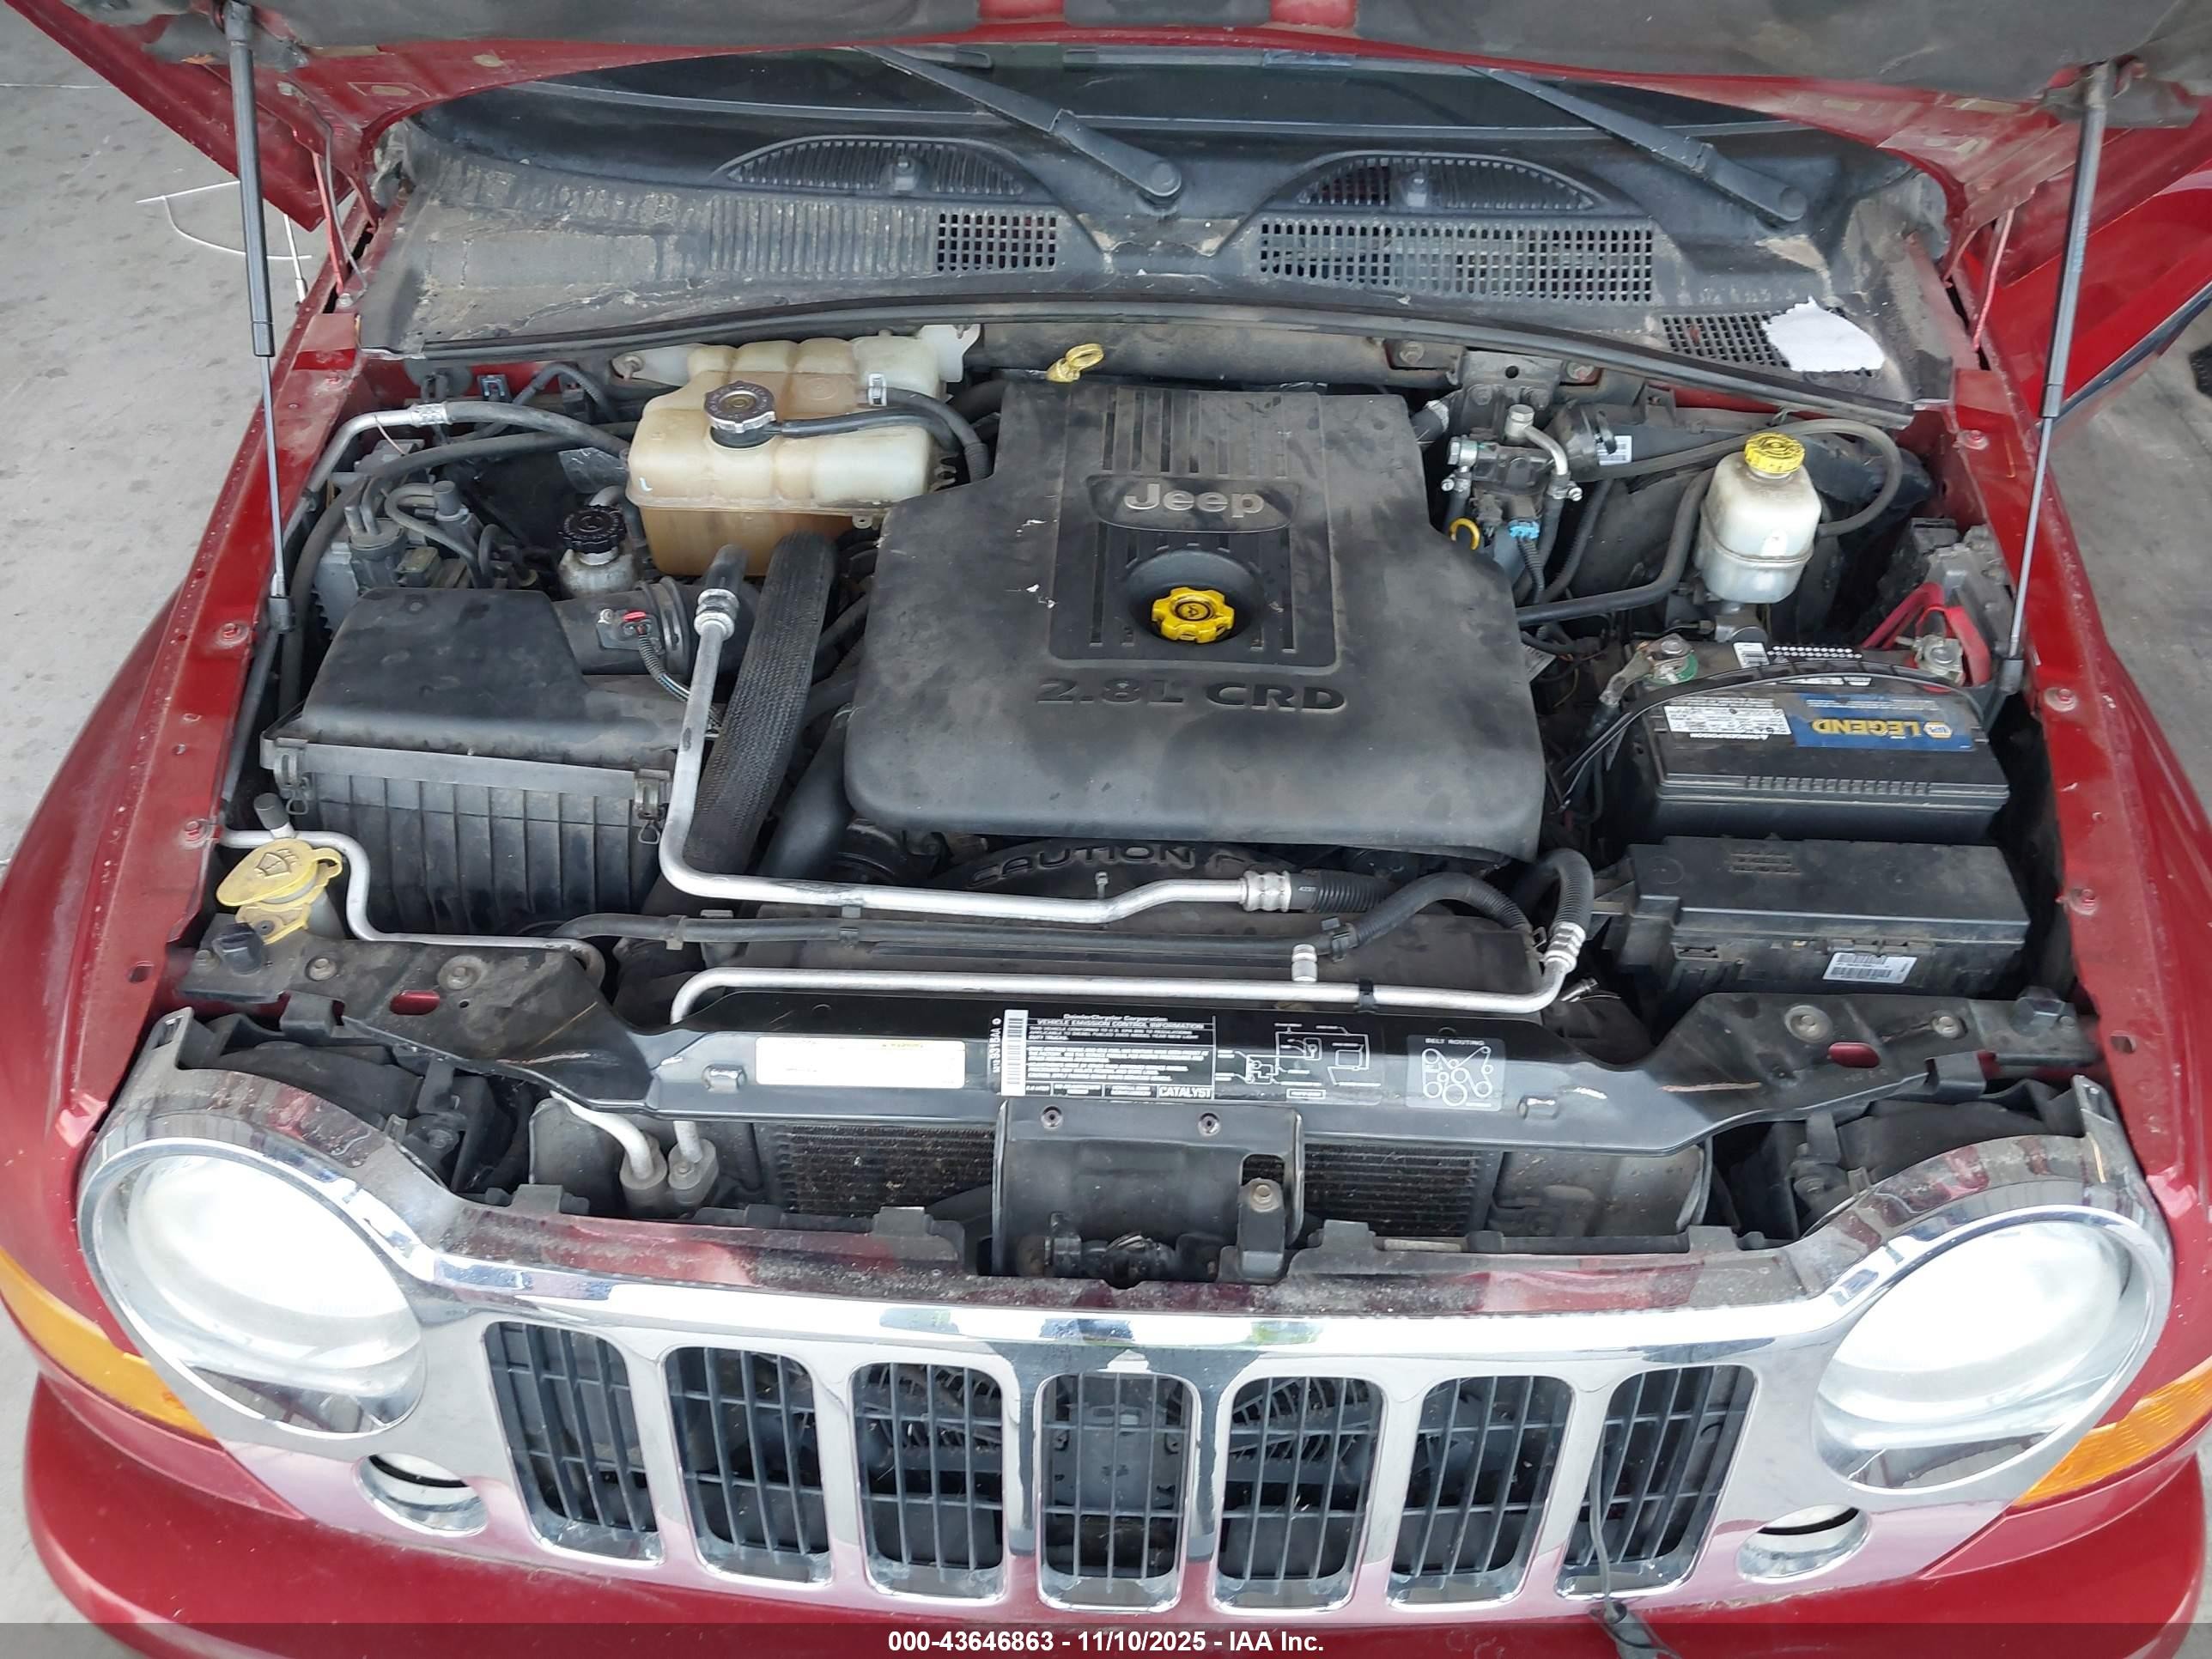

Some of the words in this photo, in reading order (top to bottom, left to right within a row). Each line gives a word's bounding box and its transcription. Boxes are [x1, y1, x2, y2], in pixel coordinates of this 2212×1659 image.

[1122, 483, 1267, 519] Jeep
[1036, 678, 1185, 706] 2.8L
[1206, 681, 1347, 714] CRD
[1813, 718, 1922, 736] LEGEND
[1159, 1085, 1212, 1099] CATALYST
